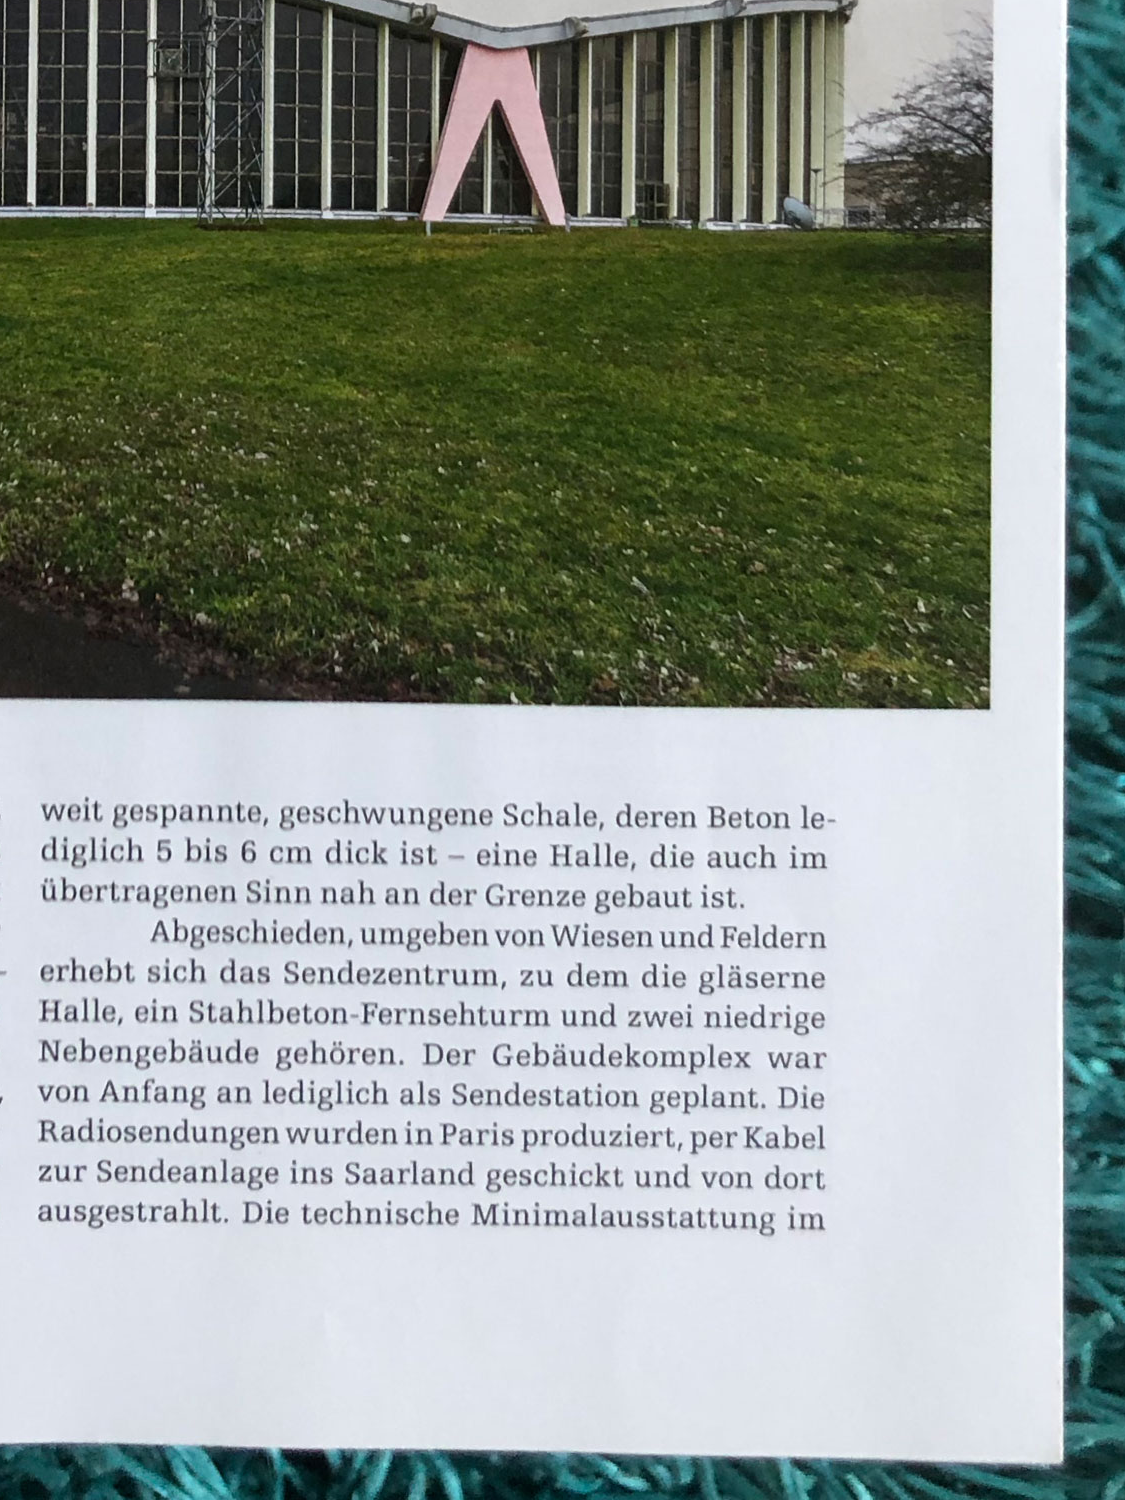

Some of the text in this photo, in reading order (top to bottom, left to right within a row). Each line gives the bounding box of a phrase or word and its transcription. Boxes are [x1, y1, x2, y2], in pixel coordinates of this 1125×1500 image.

[41, 796, 836, 832] weit gespannte, geschwungene Schale, deren Beton le-
[150, 917, 827, 953] Abgeschieden, umgeben von Wiesen und Feldern
[39, 997, 826, 1036] Halle, ein Stahlbeton-Fernsehturm und zwei niedrige
[37, 1078, 825, 1115] von Anfang an lediglich als Sendestation geplant. Die
[37, 1197, 826, 1237] ausgestrahlt. Die technische Minimalausstattung im
